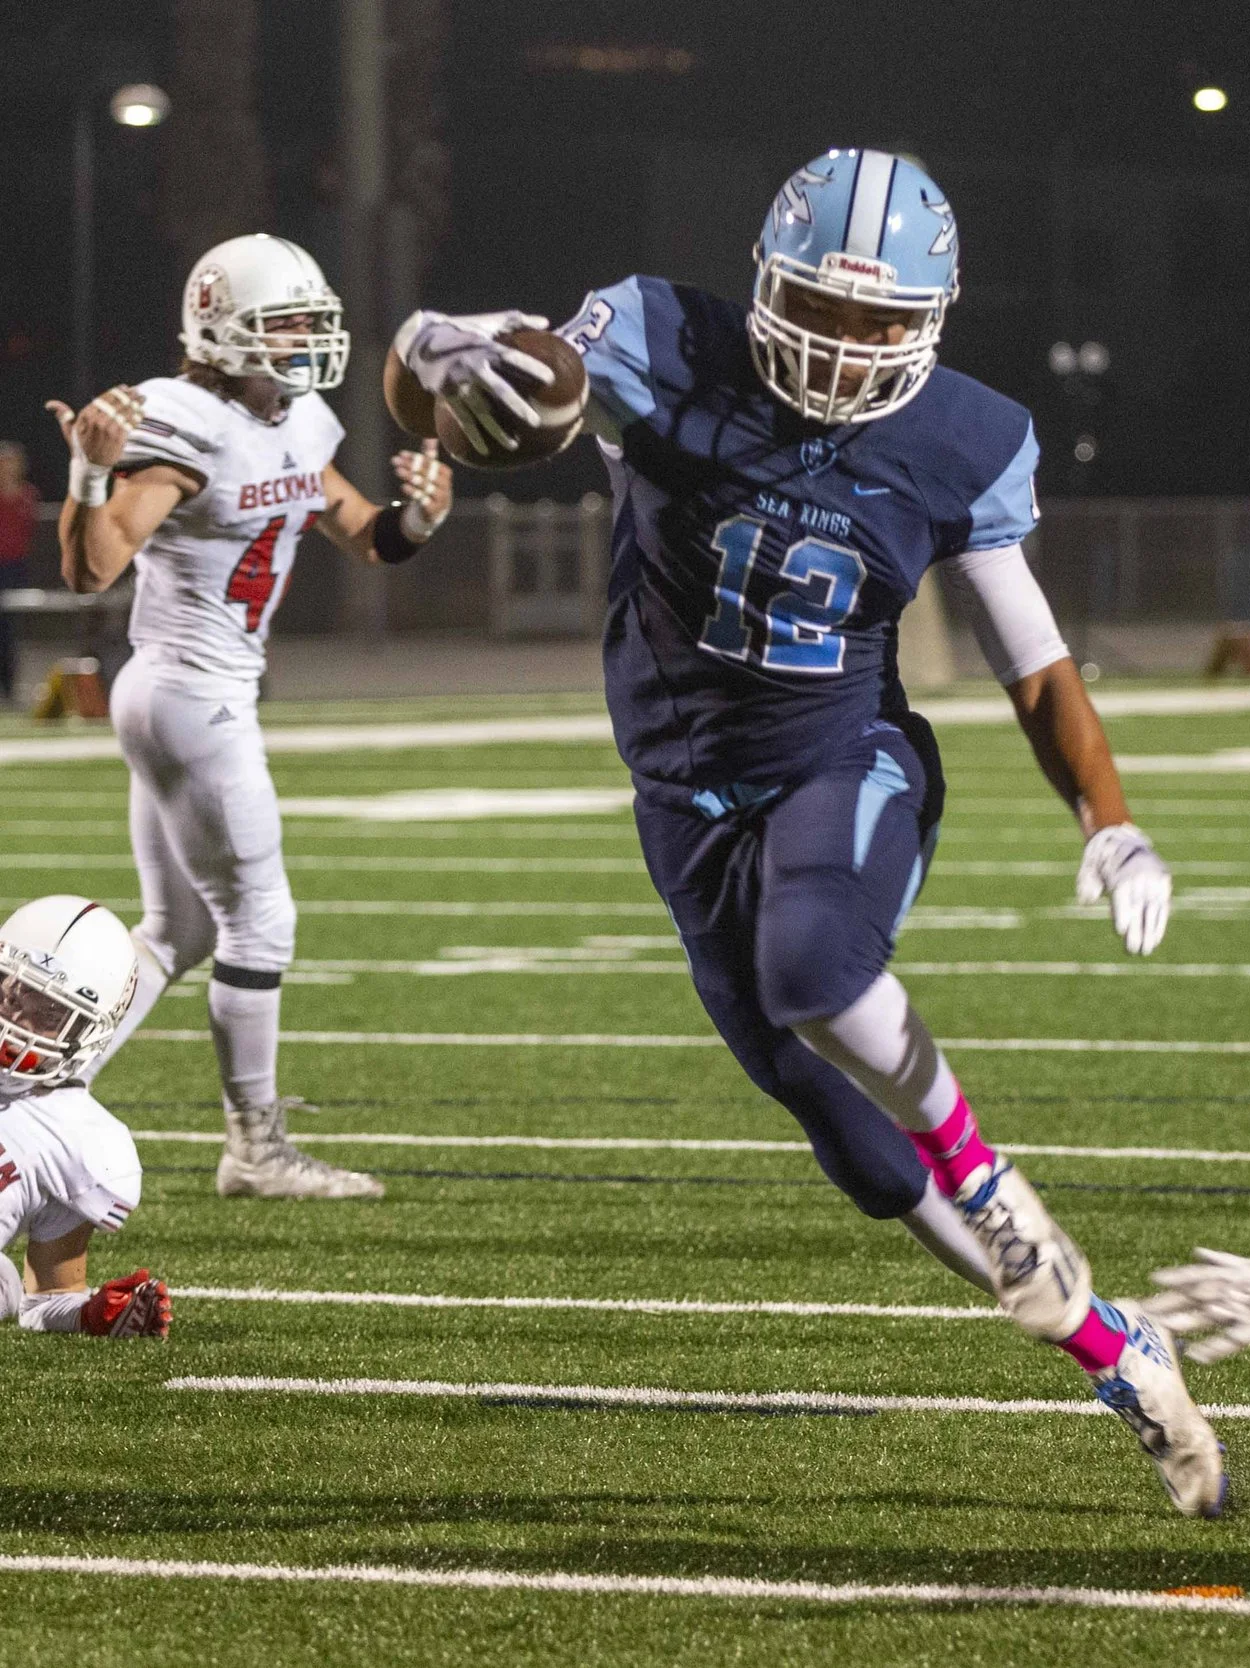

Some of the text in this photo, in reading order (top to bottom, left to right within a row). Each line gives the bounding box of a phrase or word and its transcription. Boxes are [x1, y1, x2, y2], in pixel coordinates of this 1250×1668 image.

[238, 471, 325, 511] BECKMA
[757, 492, 852, 537] SEA KINGS
[697, 512, 869, 674] 12
